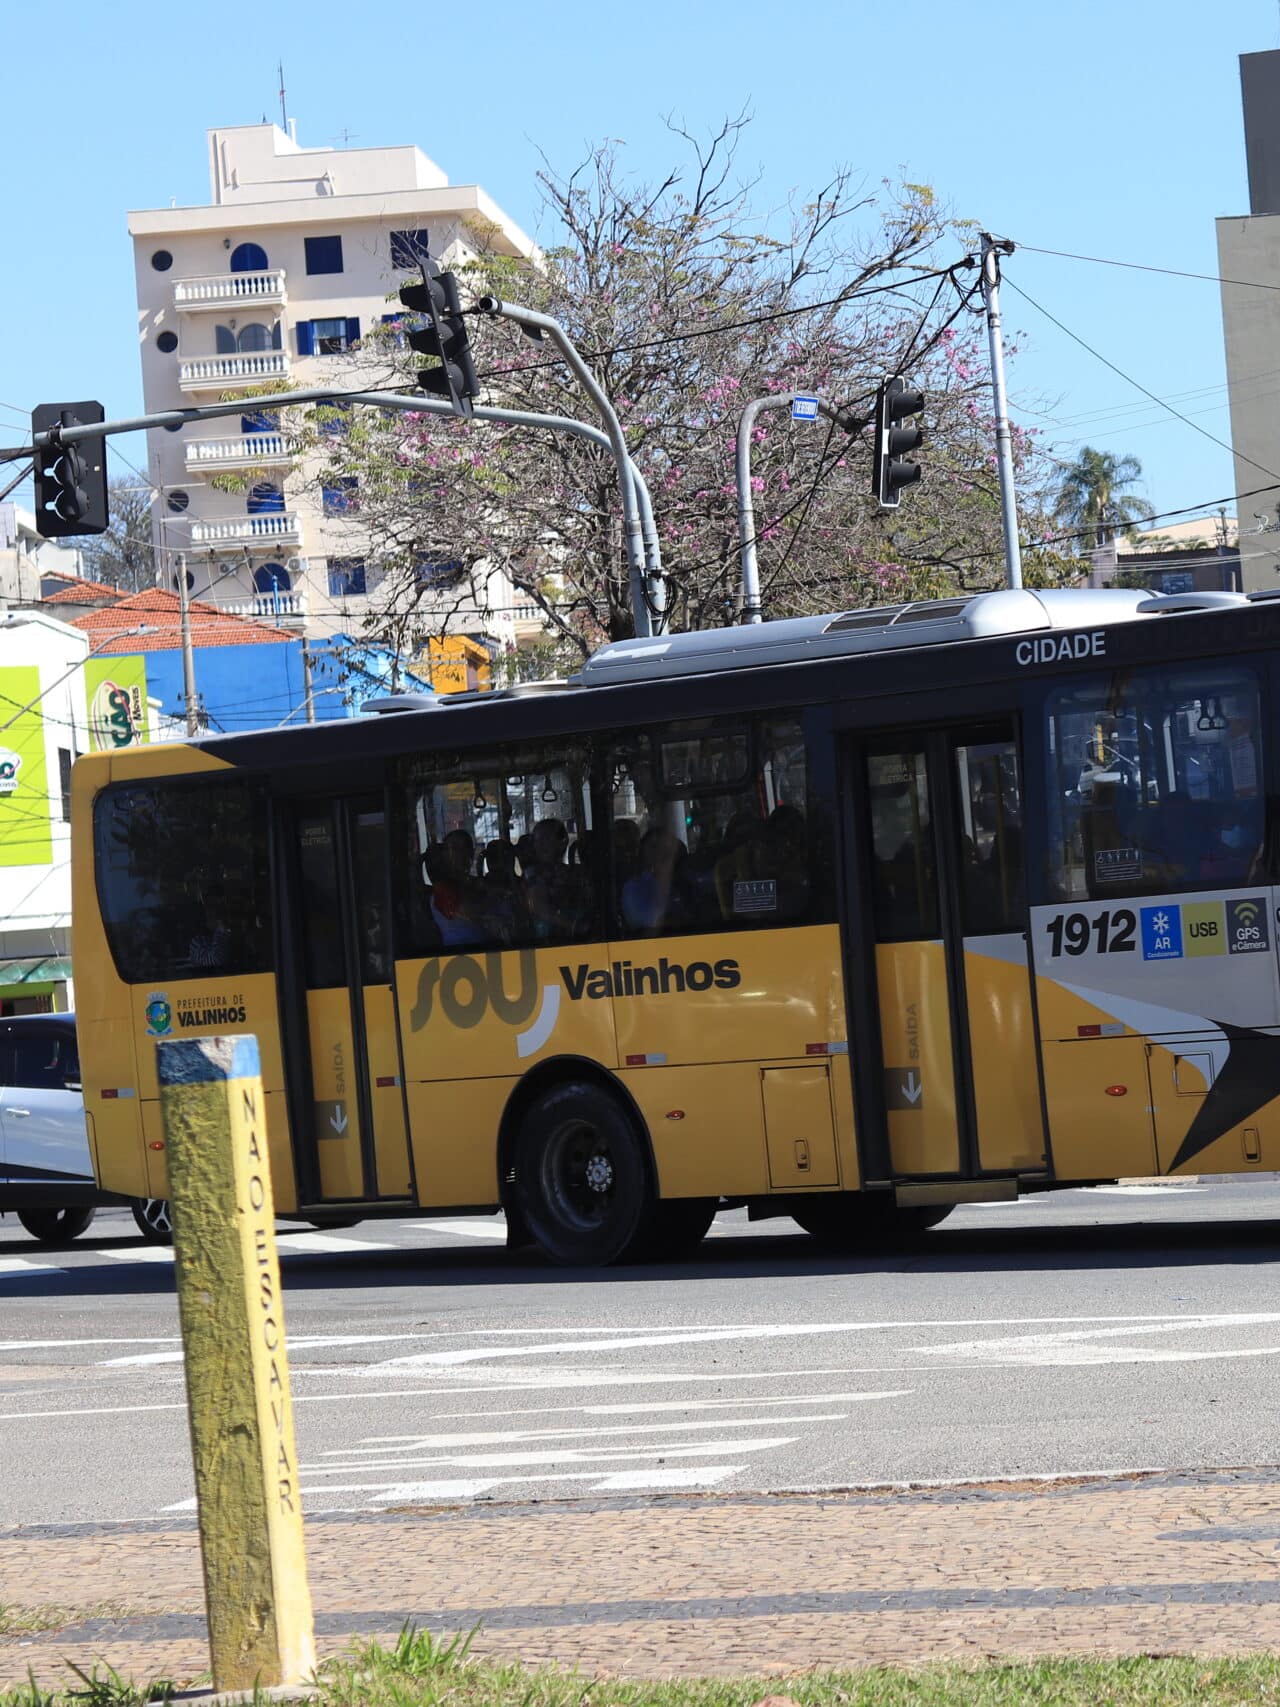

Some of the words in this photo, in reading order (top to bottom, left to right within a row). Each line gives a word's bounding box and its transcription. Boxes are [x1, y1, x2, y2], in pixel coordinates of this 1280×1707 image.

[1016, 631, 1106, 665] CIDADE
[1046, 909, 1137, 958] 1912
[1189, 922, 1218, 938] USB
[1236, 927, 1260, 941] GPS
[1154, 937, 1171, 950] AR
[559, 958, 741, 1001] Valinhos
[177, 996, 227, 1009] PREFEITURA
[233, 994, 244, 1005] DE
[177, 1006, 246, 1027] VALINHOS
